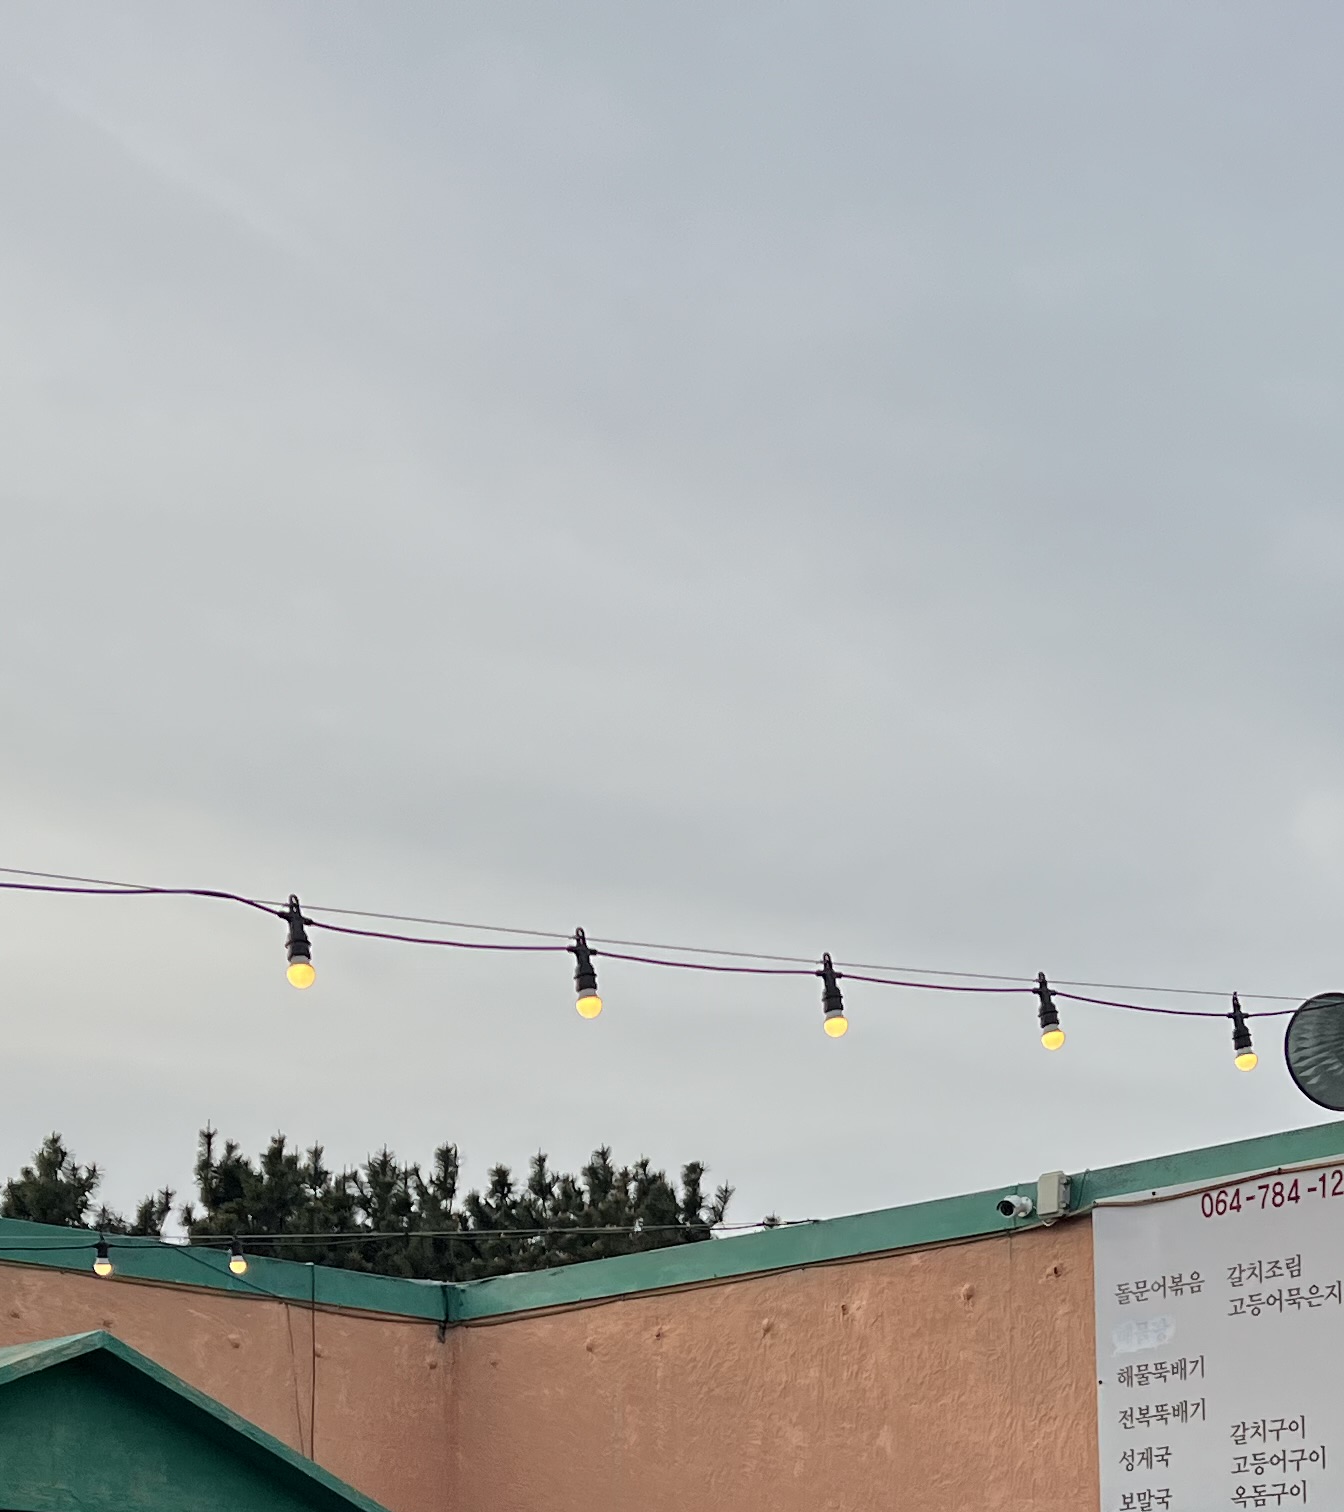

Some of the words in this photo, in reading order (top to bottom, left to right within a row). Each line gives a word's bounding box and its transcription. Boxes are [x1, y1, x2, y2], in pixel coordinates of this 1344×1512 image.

[1226, 1254, 1302, 1288] 갈치조림
[1114, 1270, 1206, 1305] 돌문어볶음
[1117, 1355, 1206, 1388] 해물뚝배기
[1118, 1398, 1207, 1430] 전복뚝배기
[1230, 1415, 1306, 1446] 갈치구이
[1119, 1446, 1173, 1472] 성게국
[1231, 1446, 1327, 1476] 고등어구이
[1119, 1488, 1173, 1512] 보말국
[1230, 1480, 1308, 1509] 옥돔구이
